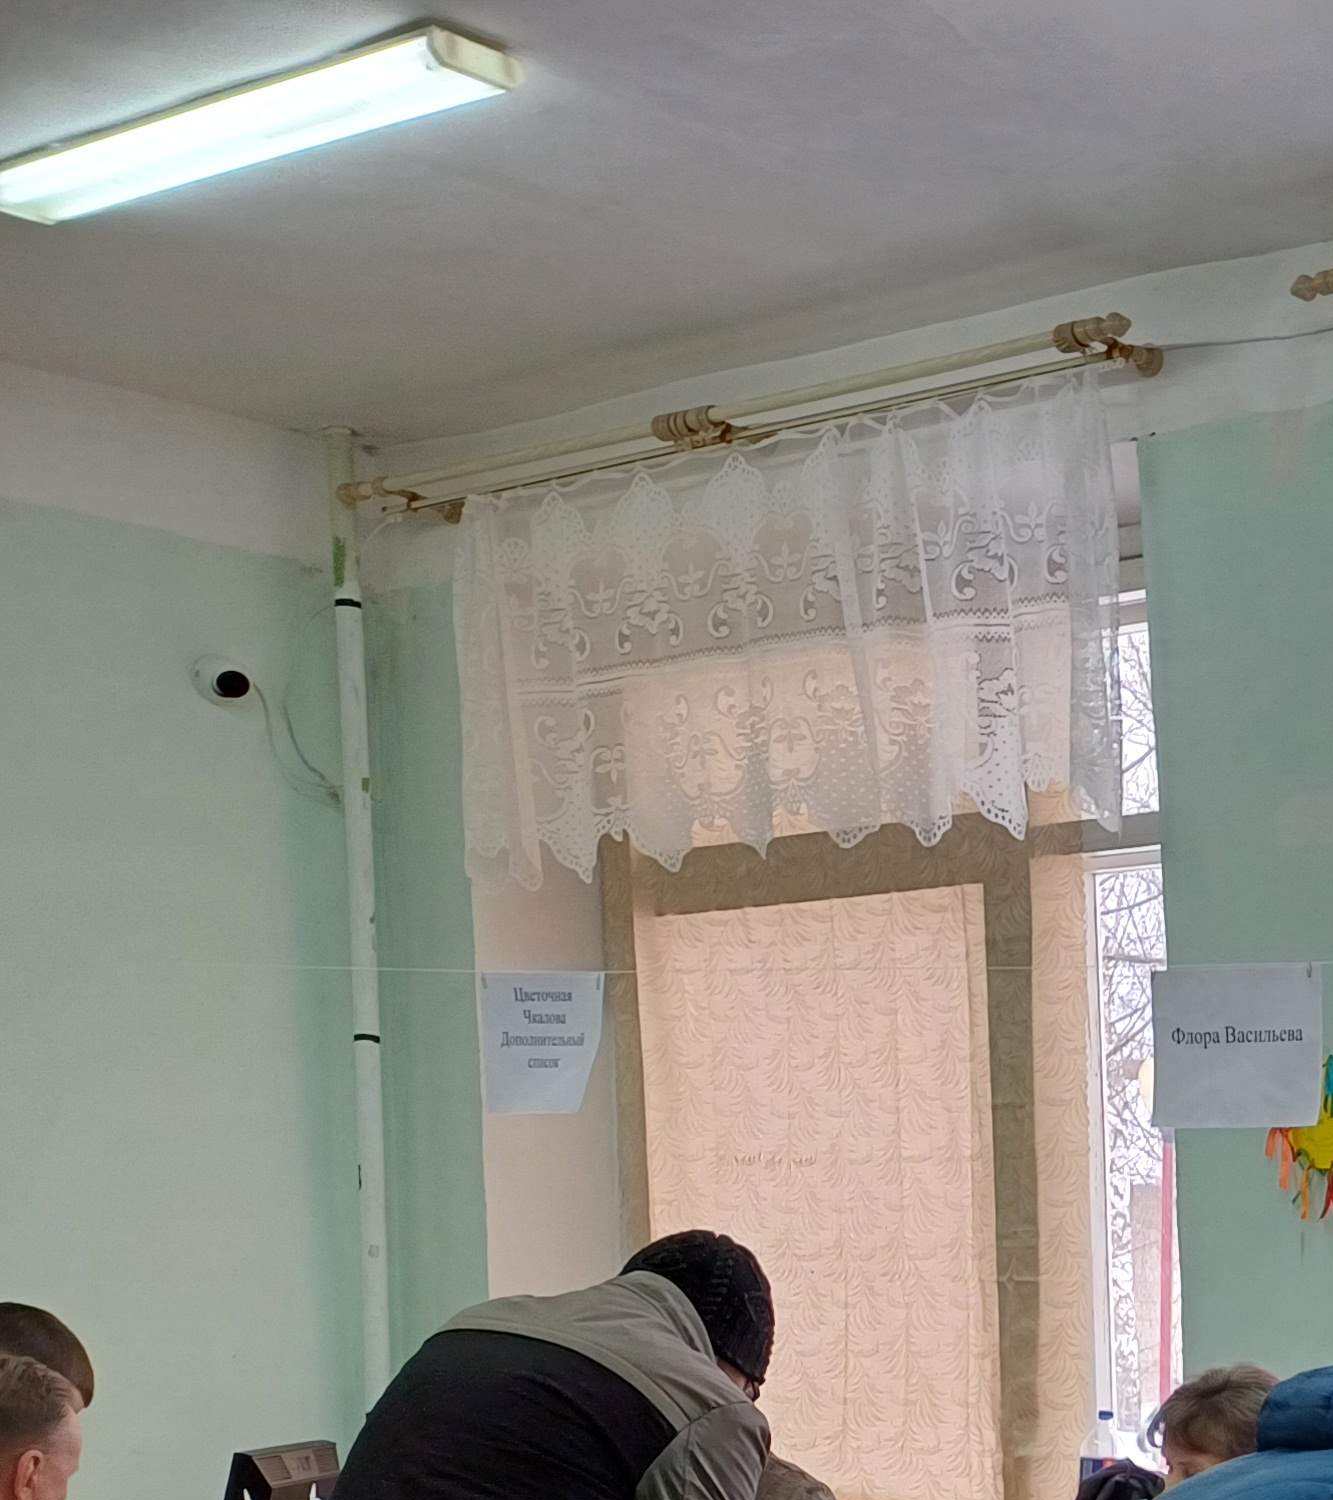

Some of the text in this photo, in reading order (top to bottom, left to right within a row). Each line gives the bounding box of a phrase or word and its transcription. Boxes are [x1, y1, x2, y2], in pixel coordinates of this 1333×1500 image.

[513, 986, 573, 1003] Цветочная
[522, 1008, 567, 1025] Чкалова
[1171, 1025, 1304, 1050] Флора Васильева
